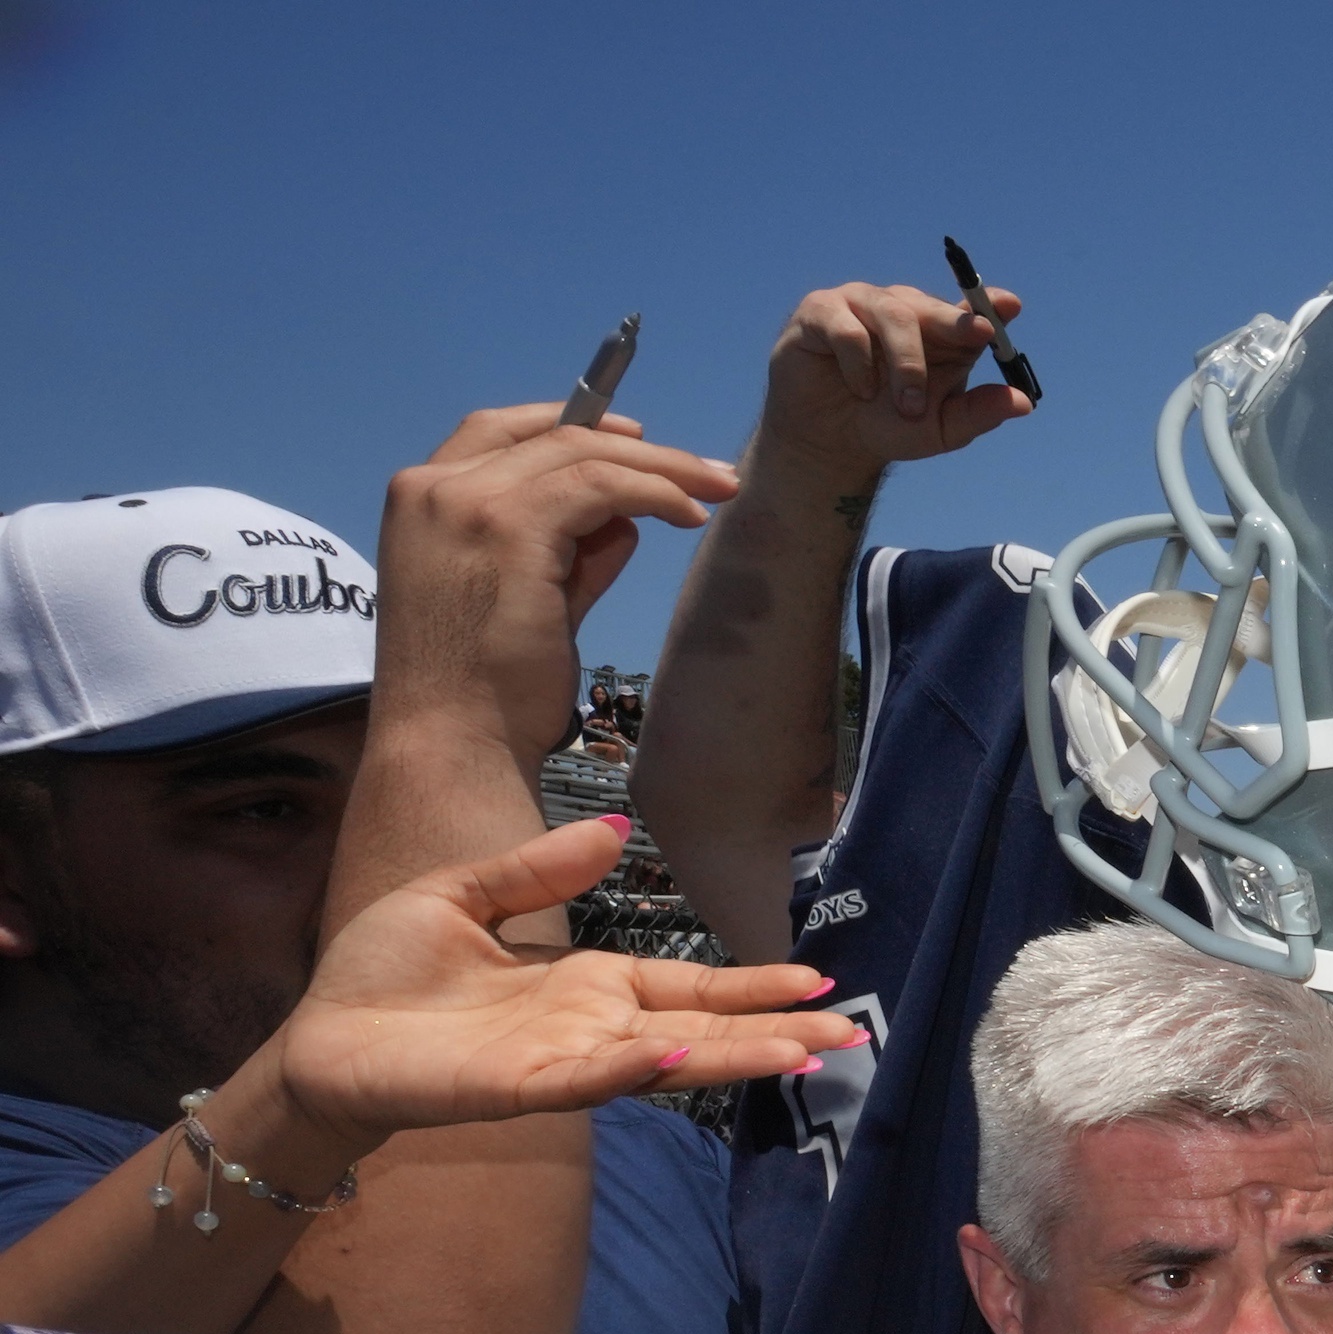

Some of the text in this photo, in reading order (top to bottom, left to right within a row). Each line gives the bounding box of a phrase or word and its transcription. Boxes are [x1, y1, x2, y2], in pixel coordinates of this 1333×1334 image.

[238, 529, 338, 556] DALLAS
[141, 543, 377, 629] Cowbo
[804, 888, 868, 930] OYS
